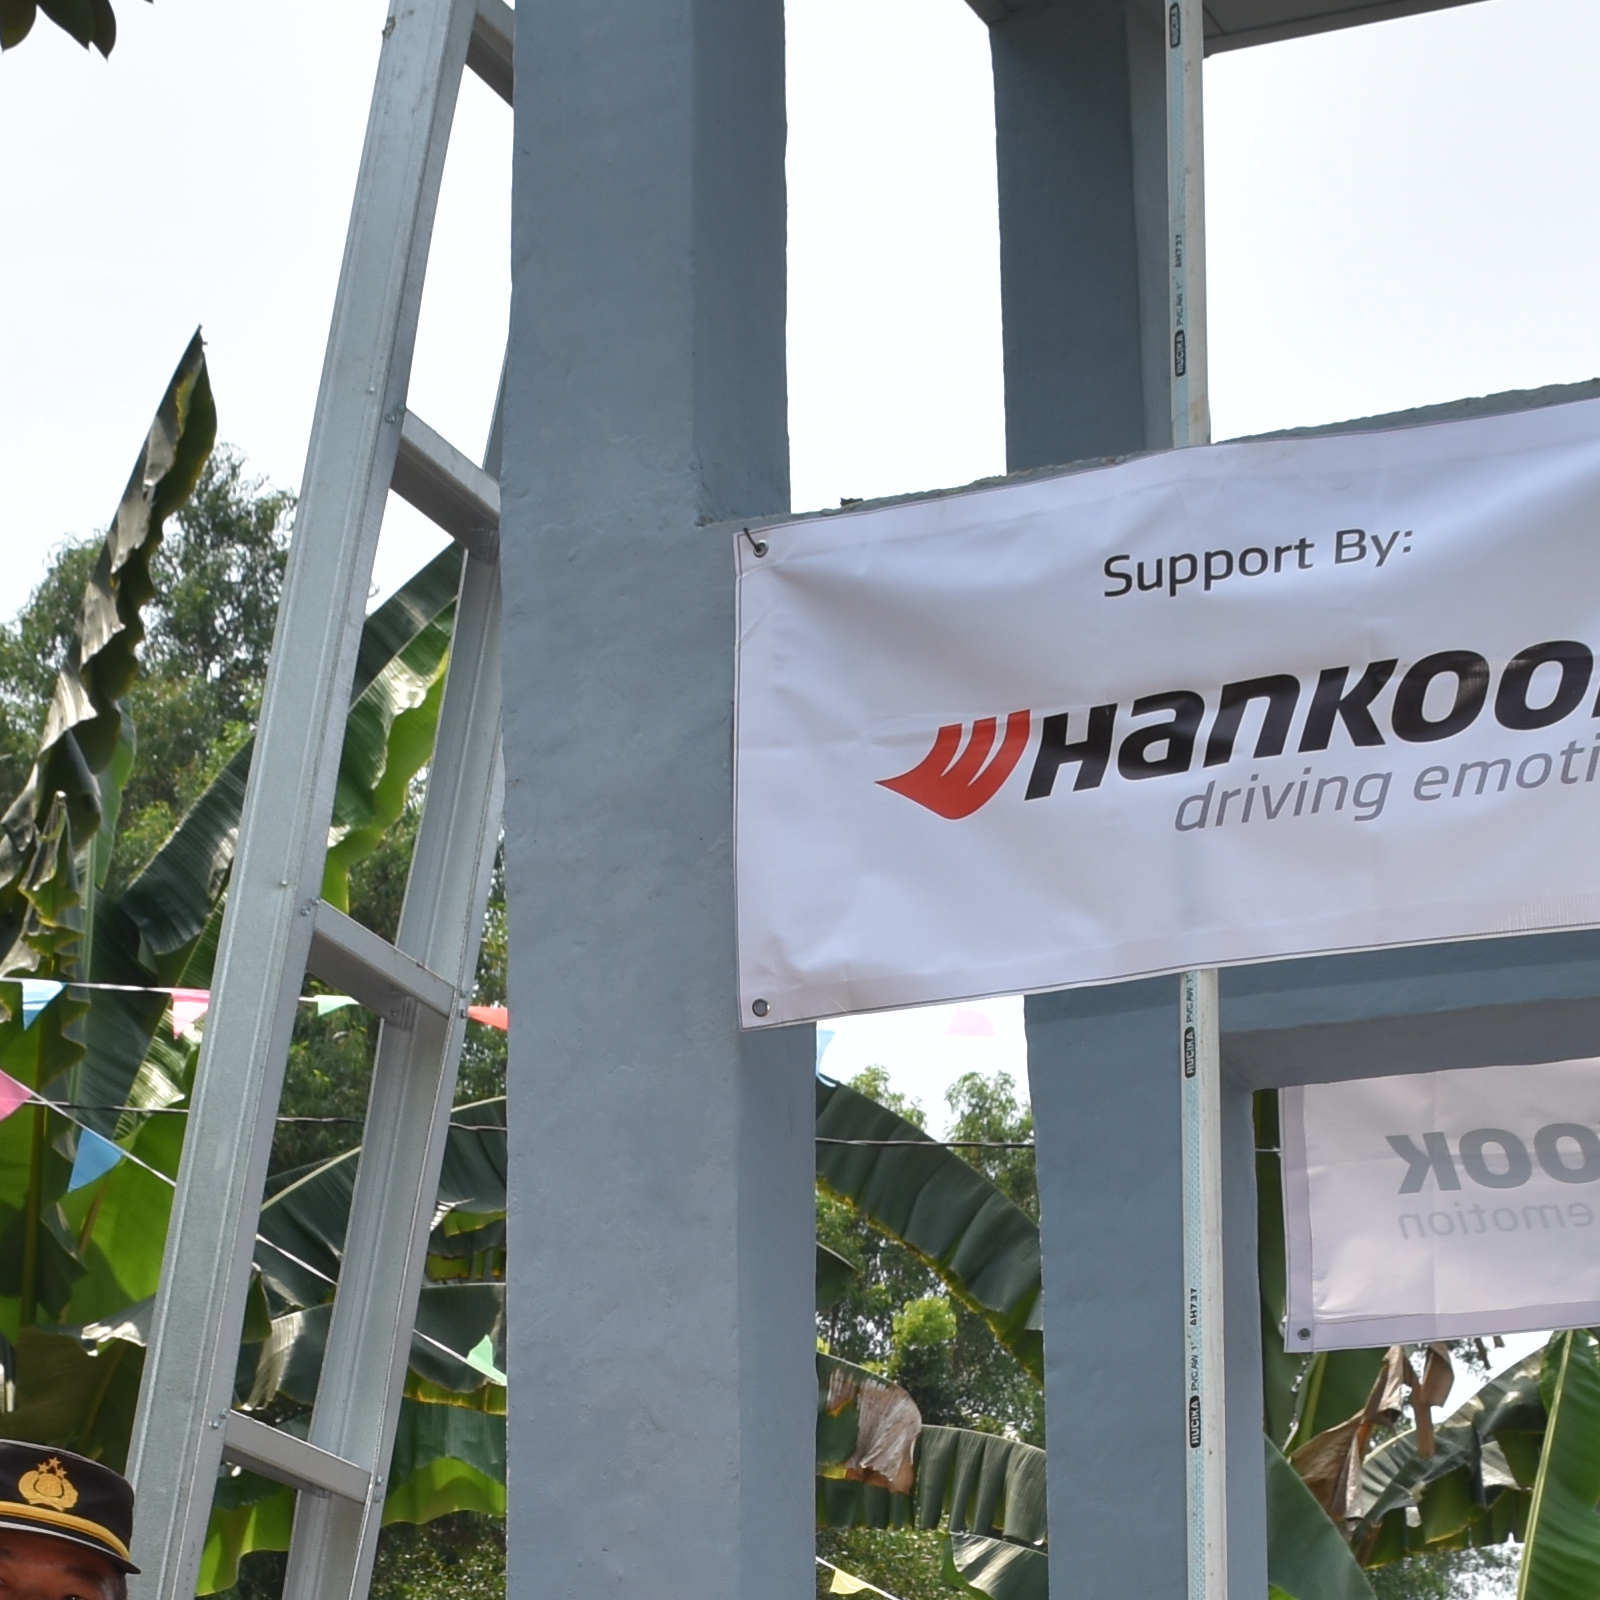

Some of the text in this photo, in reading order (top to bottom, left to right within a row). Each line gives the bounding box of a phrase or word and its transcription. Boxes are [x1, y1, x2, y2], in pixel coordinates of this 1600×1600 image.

[1103, 528, 1413, 598] Support By:
[1174, 767, 1392, 833] driving
[1186, 1030, 1195, 1075] RUCIKA
[1189, 1287, 1198, 1326] AH737
[1191, 1399, 1199, 1444] RUCIKA
